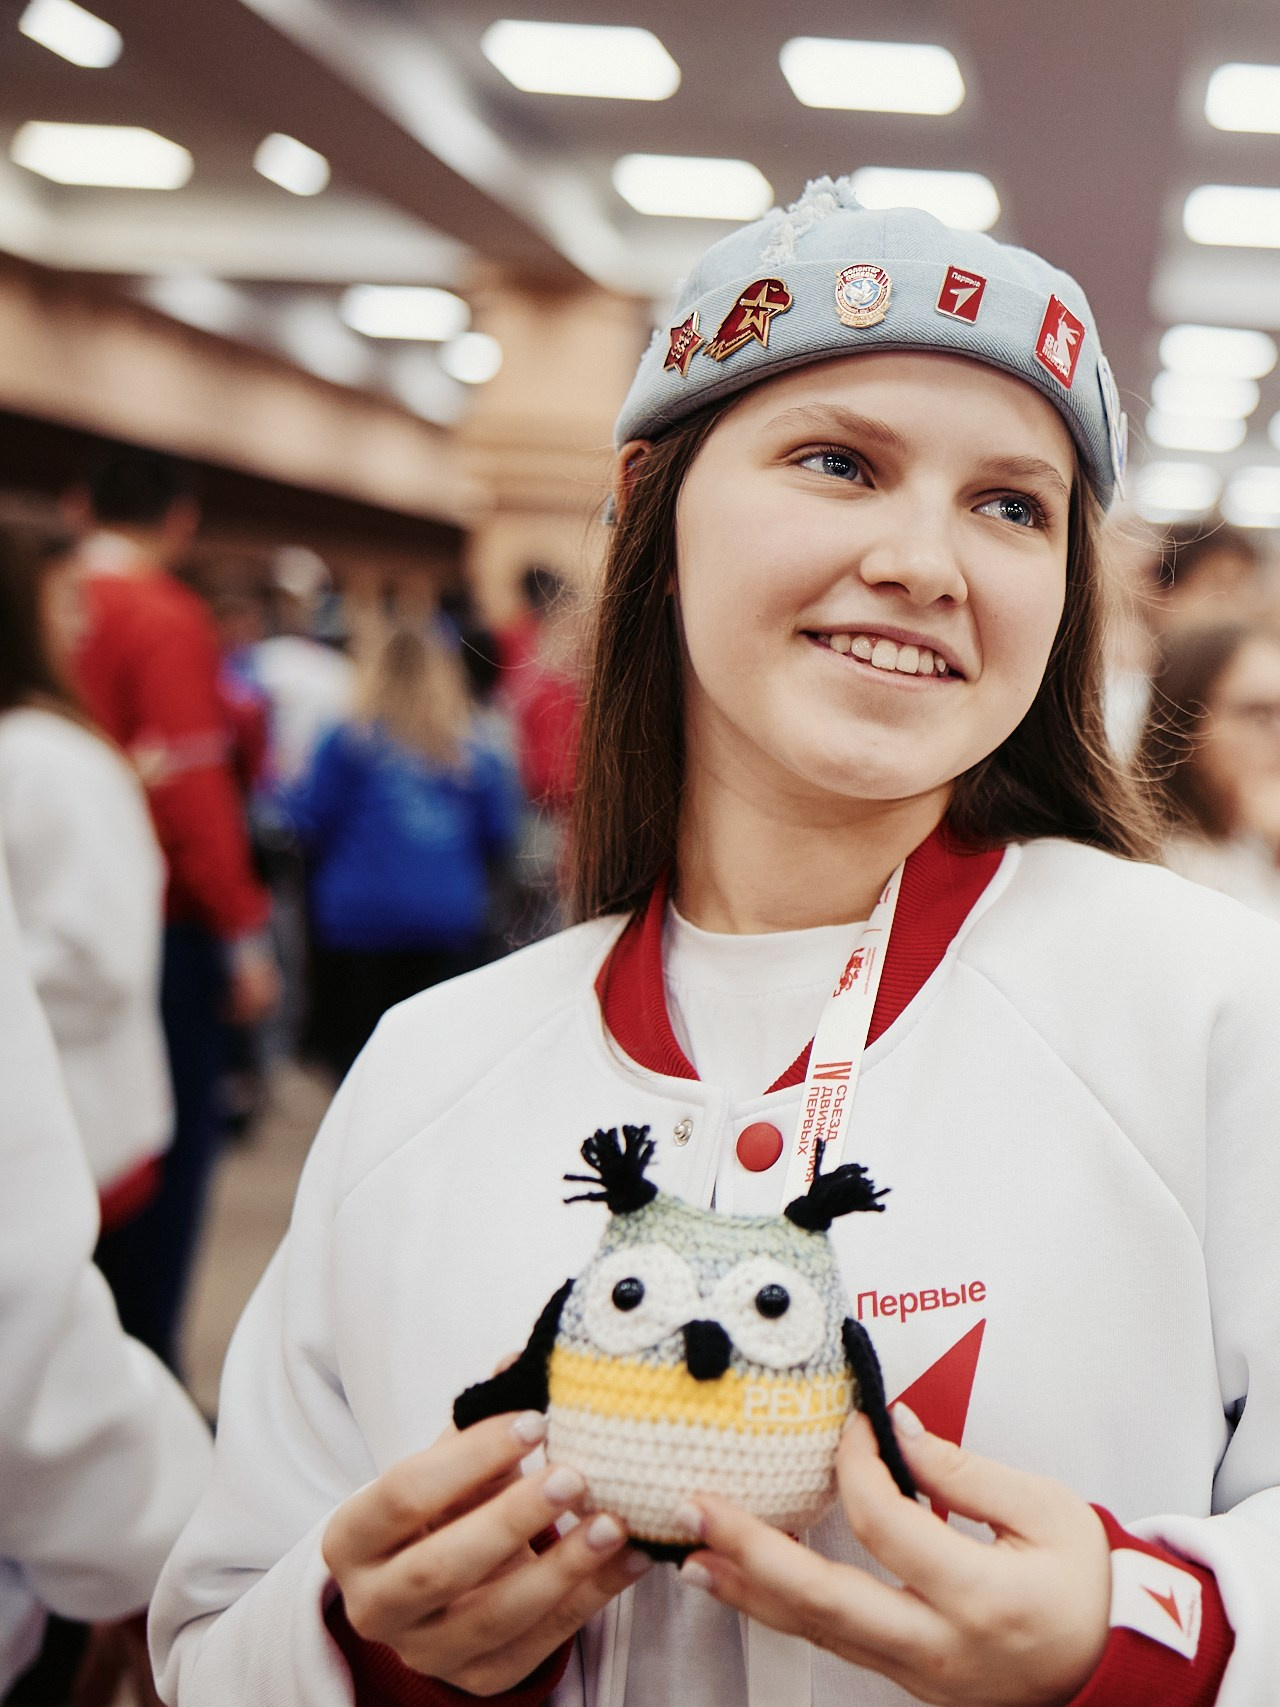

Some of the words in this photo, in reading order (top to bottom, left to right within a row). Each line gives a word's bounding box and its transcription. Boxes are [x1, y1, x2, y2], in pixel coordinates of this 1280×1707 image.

[813, 1061, 853, 1080] IV
[797, 1087, 820, 1156] ПЕРВЫХ
[826, 1085, 848, 1142] СЪЕЗД
[857, 1281, 986, 1322] Первые
